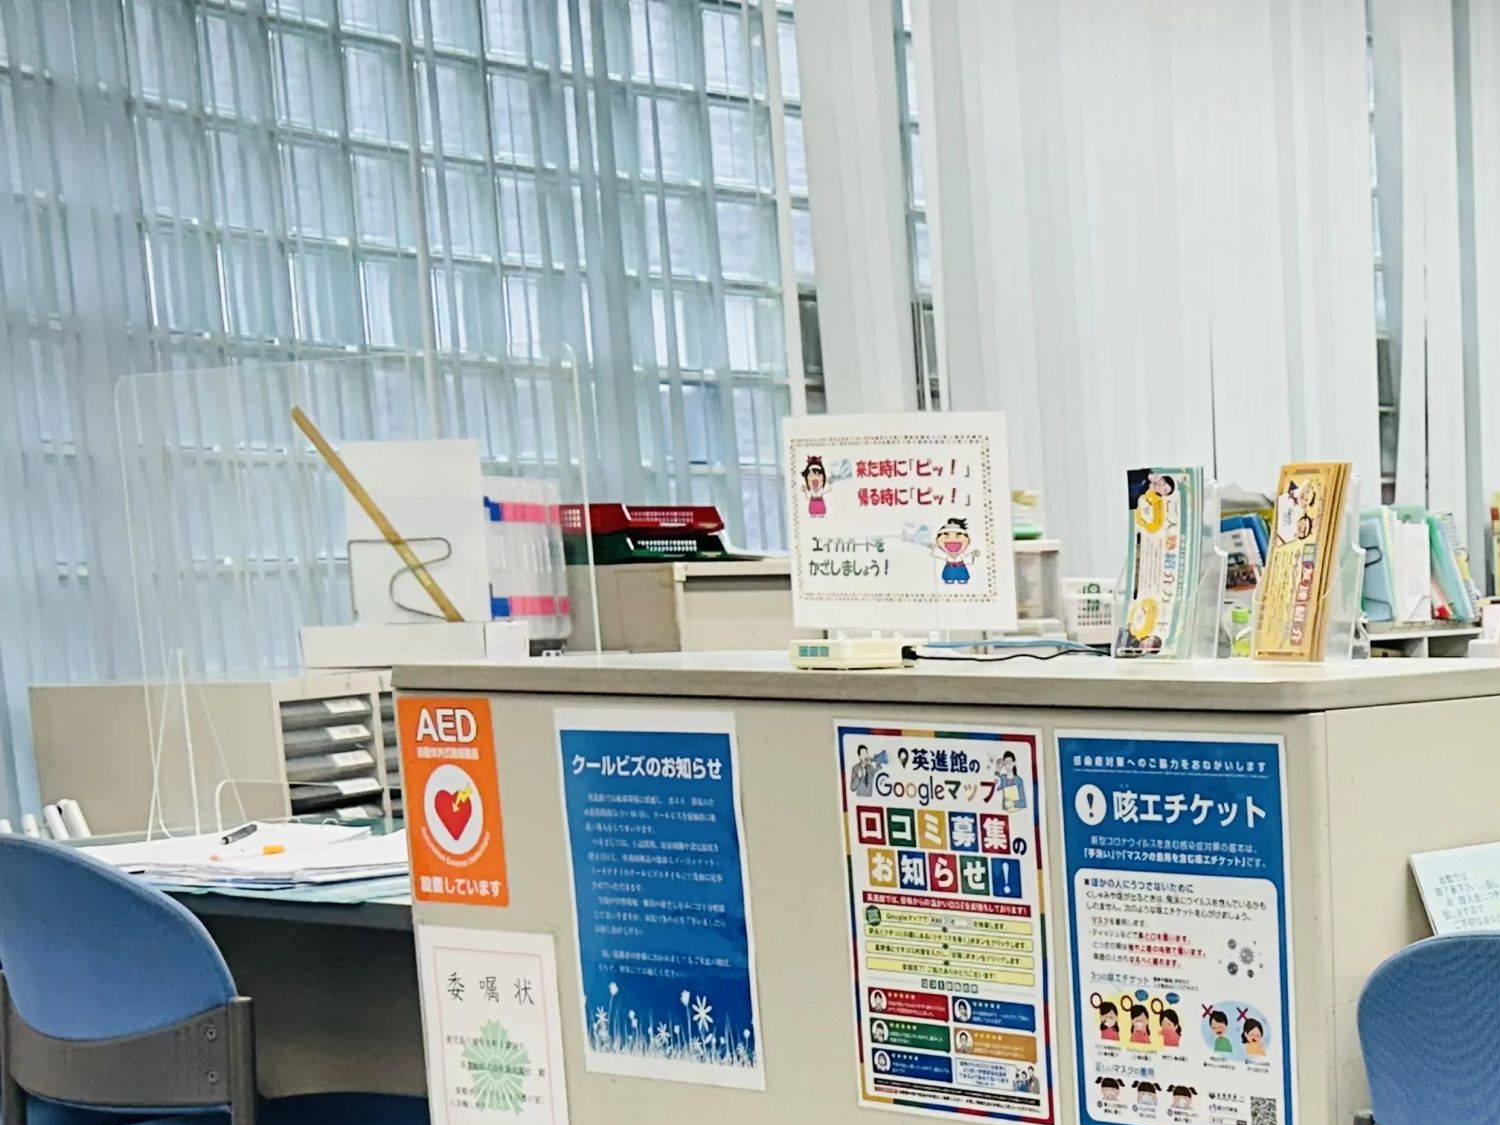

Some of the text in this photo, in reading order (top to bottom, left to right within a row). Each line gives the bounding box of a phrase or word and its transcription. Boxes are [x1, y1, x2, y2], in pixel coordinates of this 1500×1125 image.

[416, 708, 478, 743] AED
[572, 754, 722, 780] クールビズのお知らせ
[911, 748, 980, 774] 英進館の
[1073, 755, 1267, 773] 感染症対策へのご協力をおねがいします
[875, 772, 1000, 806] Googleマップ
[1112, 789, 1266, 828] 咳エチケット
[860, 811, 1027, 855] 口コミ募集の
[871, 852, 1012, 895] お知らせ！
